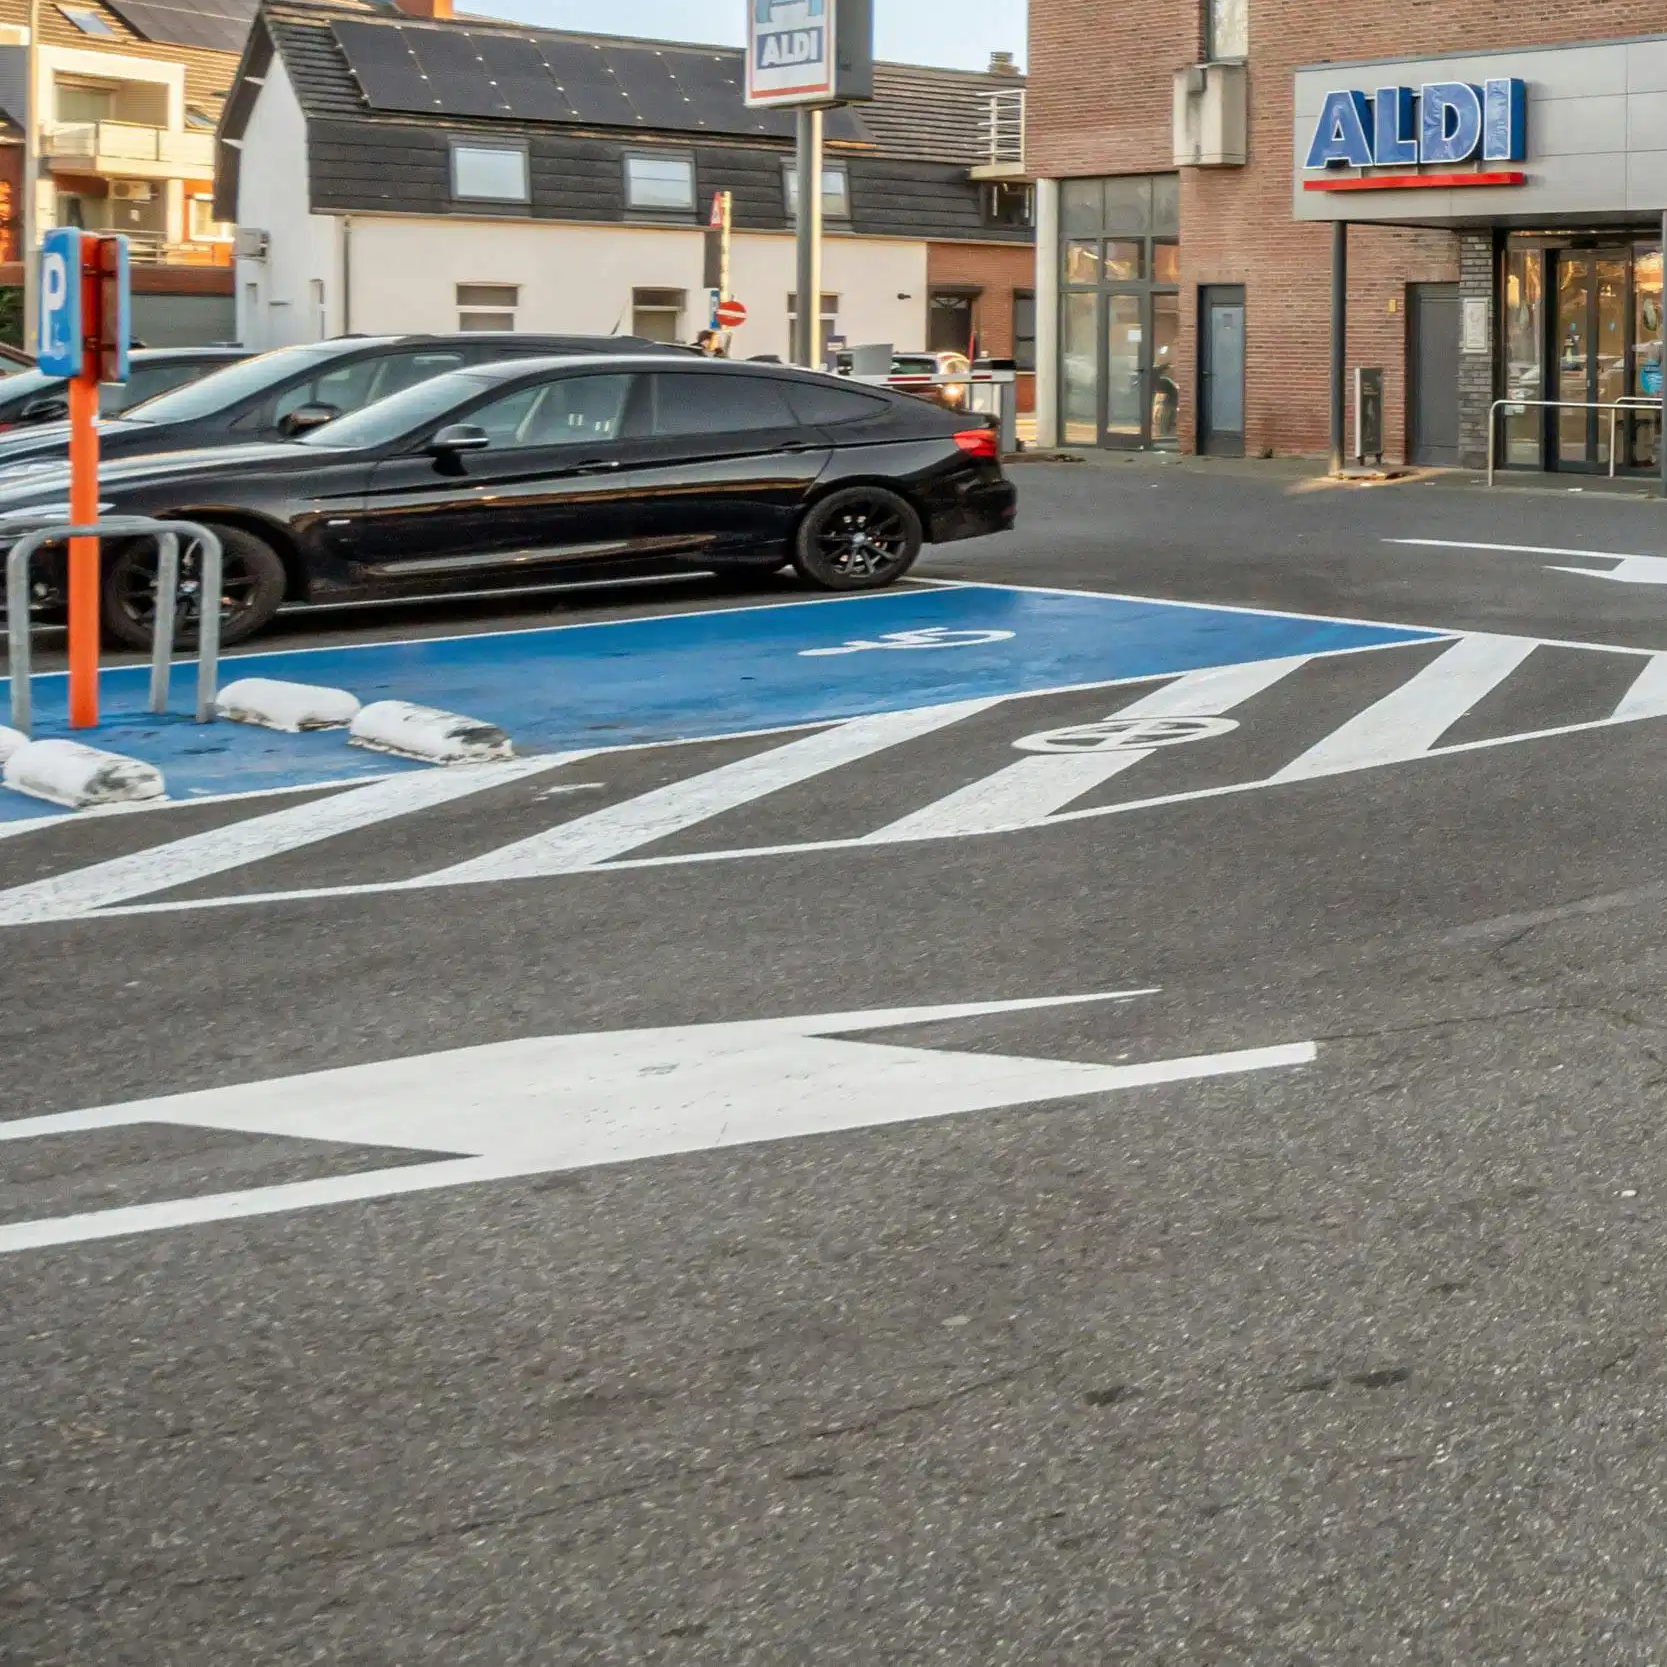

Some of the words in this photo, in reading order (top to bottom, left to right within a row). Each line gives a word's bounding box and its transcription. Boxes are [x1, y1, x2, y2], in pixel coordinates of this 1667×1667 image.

[760, 29, 819, 67] ALDI
[1303, 78, 1525, 170] ALDI
[42, 252, 67, 353] P
